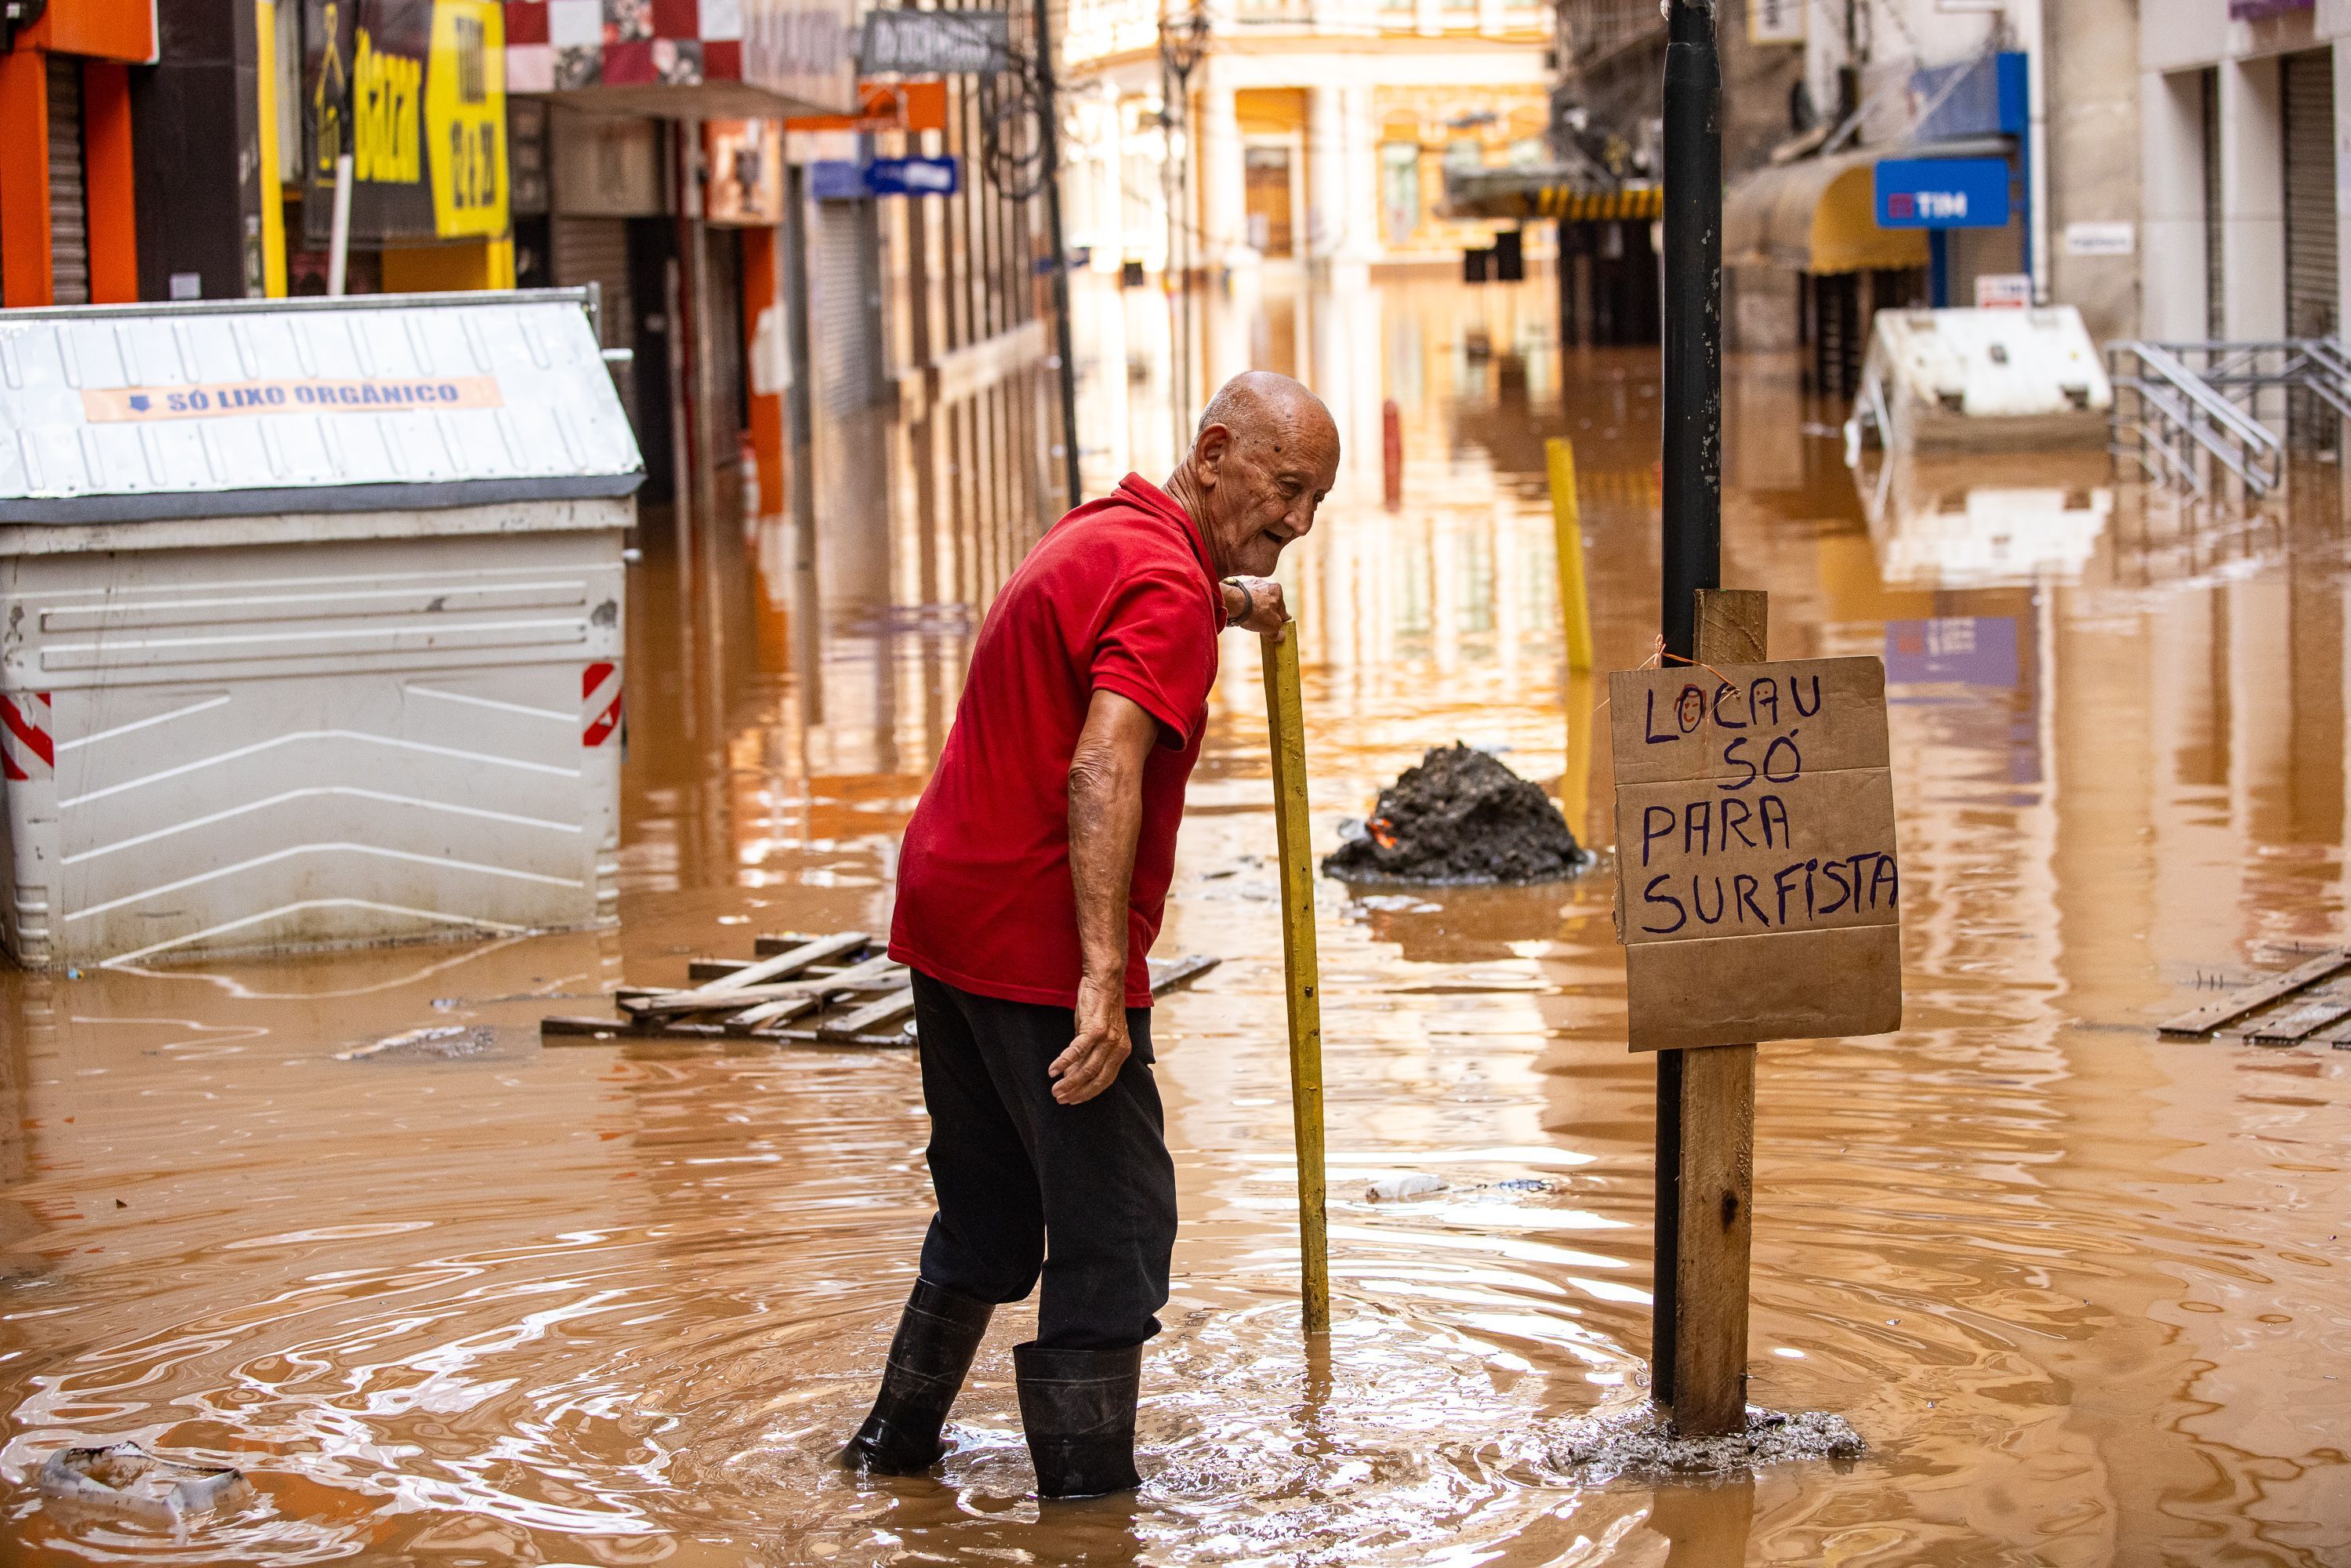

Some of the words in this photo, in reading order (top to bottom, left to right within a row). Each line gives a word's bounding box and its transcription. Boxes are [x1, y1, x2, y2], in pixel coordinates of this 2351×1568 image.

[1915, 191, 1968, 220] TIM
[166, 389, 210, 412] SÓ
[217, 386, 287, 409] LIXO
[294, 383, 459, 405] ORGÂNICO
[1645, 675, 1821, 744] LOCAU
[1718, 728, 1801, 790] SÓ
[1642, 795, 1790, 866] PARA
